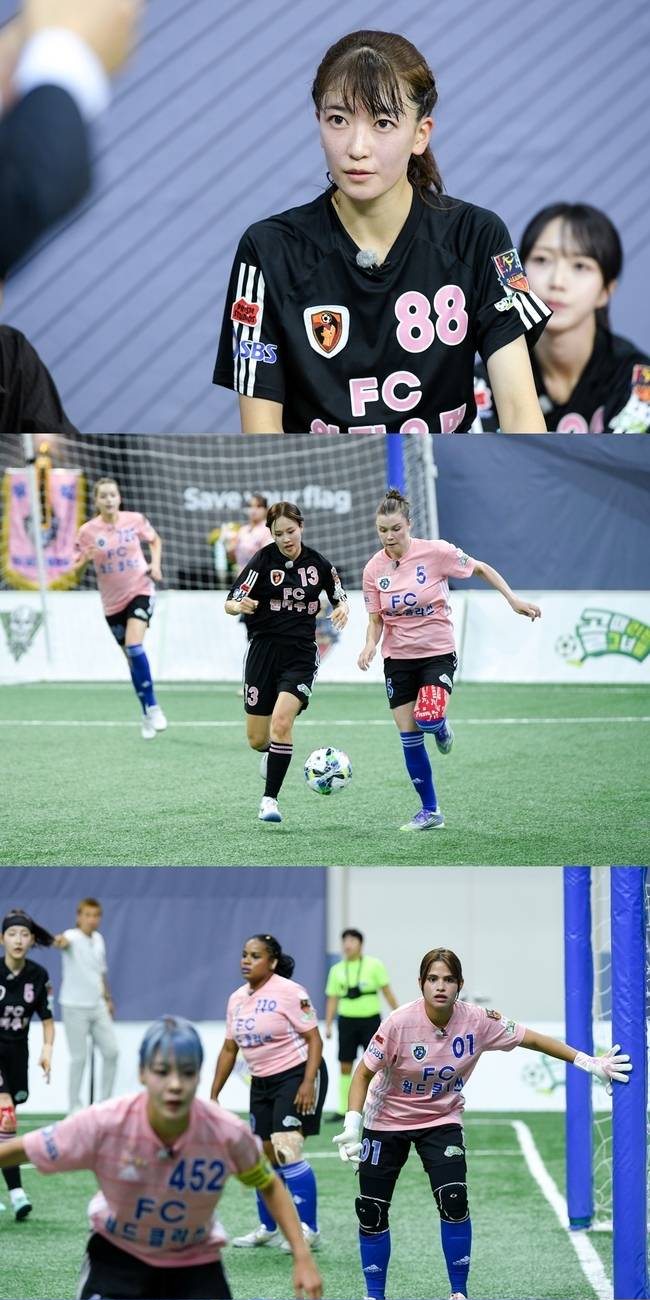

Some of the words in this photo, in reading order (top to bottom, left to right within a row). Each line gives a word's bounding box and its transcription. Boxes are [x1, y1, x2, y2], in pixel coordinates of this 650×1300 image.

[394, 284, 468, 353] 88
[239, 340, 278, 364] SBS
[349, 370, 423, 417] FC
[183, 486, 243, 512] Save
[303, 484, 353, 515] flag
[297, 565, 319, 588] 13
[415, 565, 427, 586] 5
[282, 587, 305, 600] FC
[391, 592, 418, 609] FC
[451, 1033, 476, 1059] 01
[423, 1065, 456, 1081] FC
[360, 1137, 382, 1166] 01
[168, 1158, 226, 1192] 452
[134, 1197, 187, 1223] FC
